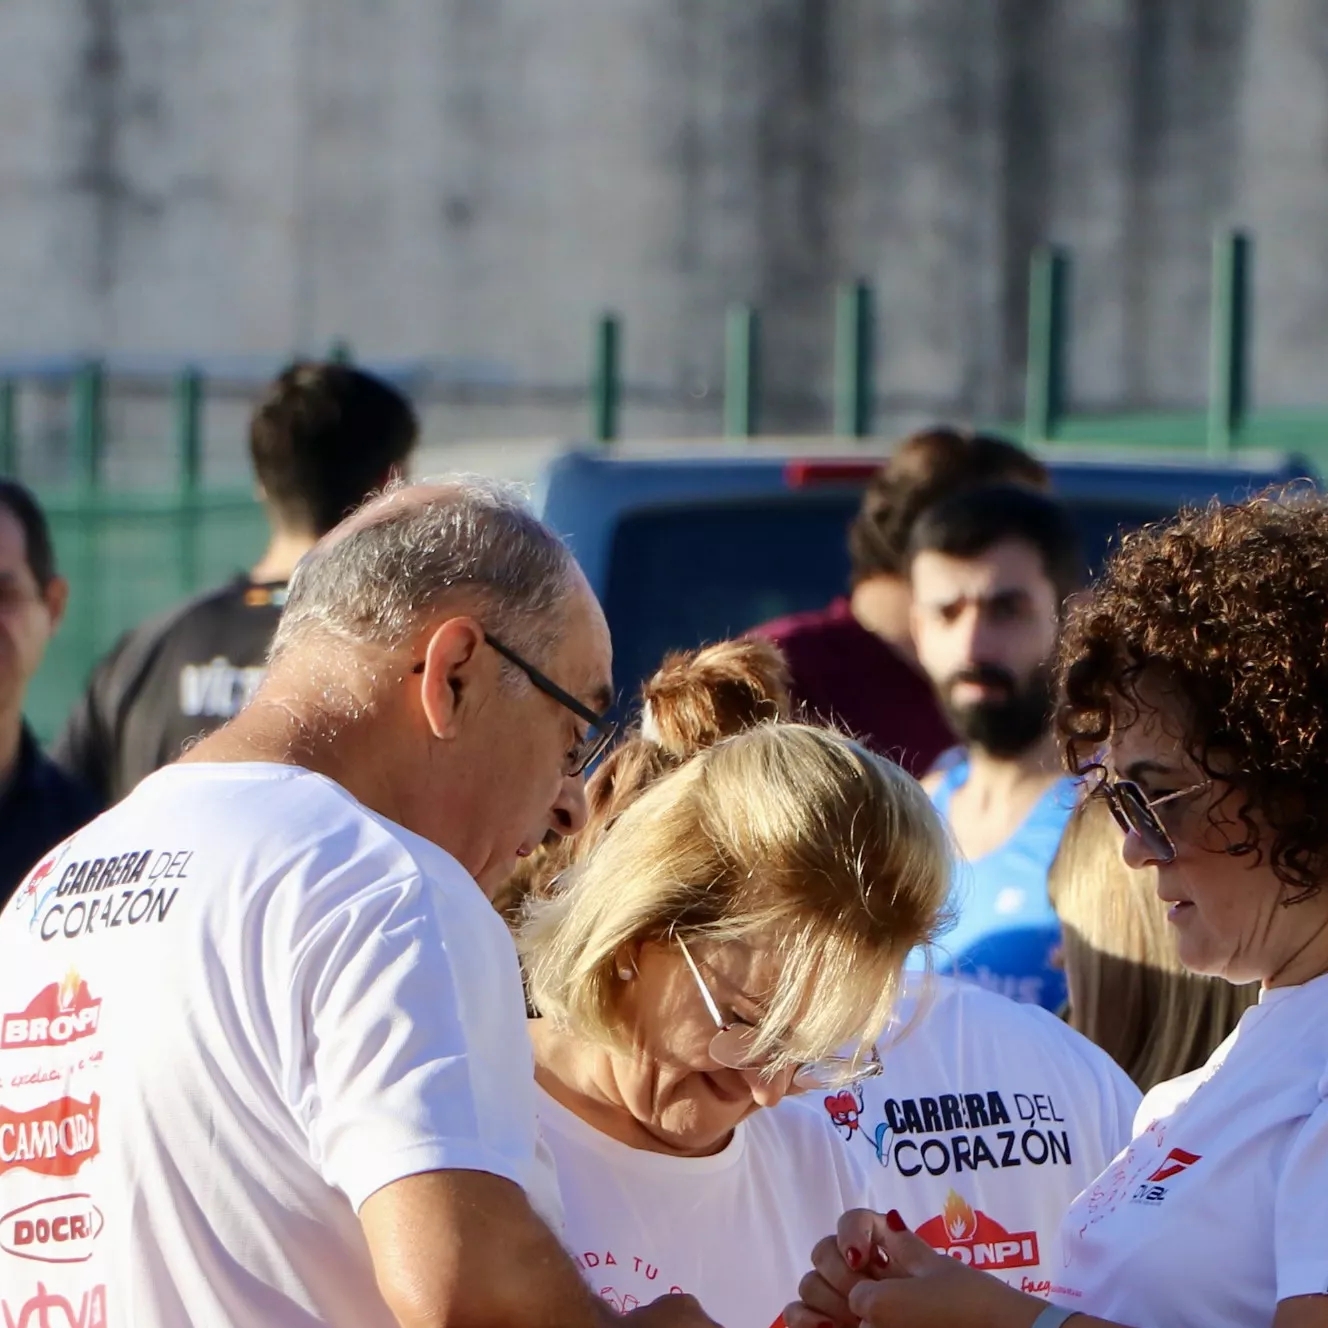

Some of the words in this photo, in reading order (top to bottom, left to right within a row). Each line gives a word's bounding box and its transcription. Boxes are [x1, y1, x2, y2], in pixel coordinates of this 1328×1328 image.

[56, 849, 154, 898] CARRERA
[148, 851, 194, 880] DEL
[40, 880, 180, 942] CORAZÓN
[1014, 1094, 1064, 1121] DEL
[894, 1120, 1072, 1177] CORAZÓN
[633, 1256, 658, 1280] TU
